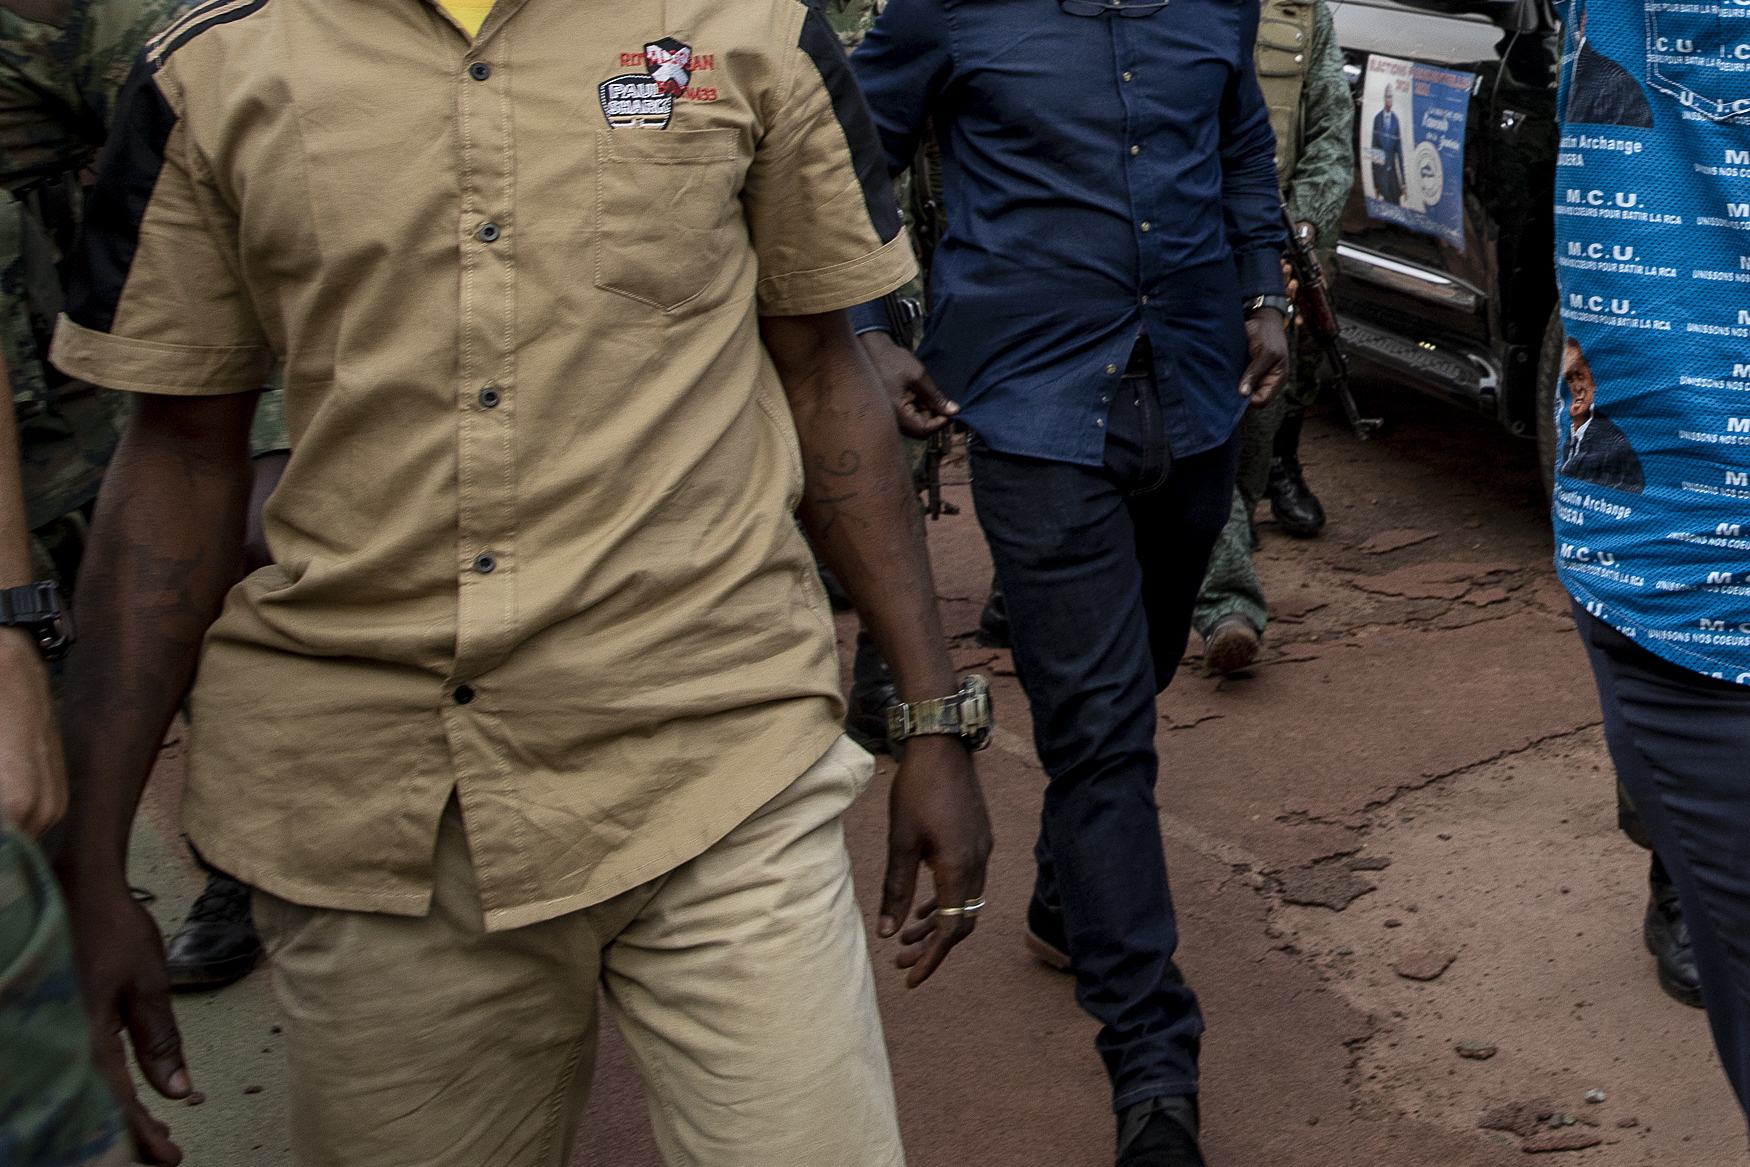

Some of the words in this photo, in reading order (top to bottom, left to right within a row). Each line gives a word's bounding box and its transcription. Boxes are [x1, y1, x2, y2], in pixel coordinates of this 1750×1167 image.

[606, 98, 671, 115] SHARK
[1578, 134, 1643, 155] Archange
[1718, 167, 1738, 178] NOS
[1566, 188, 1645, 208] M.C.U.
[1599, 208, 1622, 220] POUR
[1622, 210, 1648, 222] BATIR
[1649, 214, 1662, 222] LA
[1663, 215, 1682, 225] RCA
[1568, 241, 1641, 262] M.C.U.
[1598, 262, 1618, 272] POUR
[1618, 263, 1644, 274] BATIR
[1644, 266, 1657, 276] LA
[1658, 267, 1677, 278] RCA
[1692, 269, 1734, 282] UNISSONS
[1568, 293, 1636, 315] M.C.U.
[1616, 316, 1638, 328] BATIR
[1639, 318, 1652, 328] LA
[1652, 320, 1672, 331] RCA
[1686, 322, 1731, 336] UNISSONS
[1731, 327, 1749, 338] NOS
[1680, 376, 1726, 390] UNISSONS
[1726, 381, 1744, 391] NOS
[1678, 430, 1719, 444] UNISSONS
[1719, 435, 1738, 444] NOS
[1582, 494, 1632, 520] Archange
[1709, 538, 1728, 548] NOS
[1560, 542, 1620, 568] M.C.U.
[1692, 633, 1712, 644] NOS
[1712, 634, 1750, 646] COEURS
